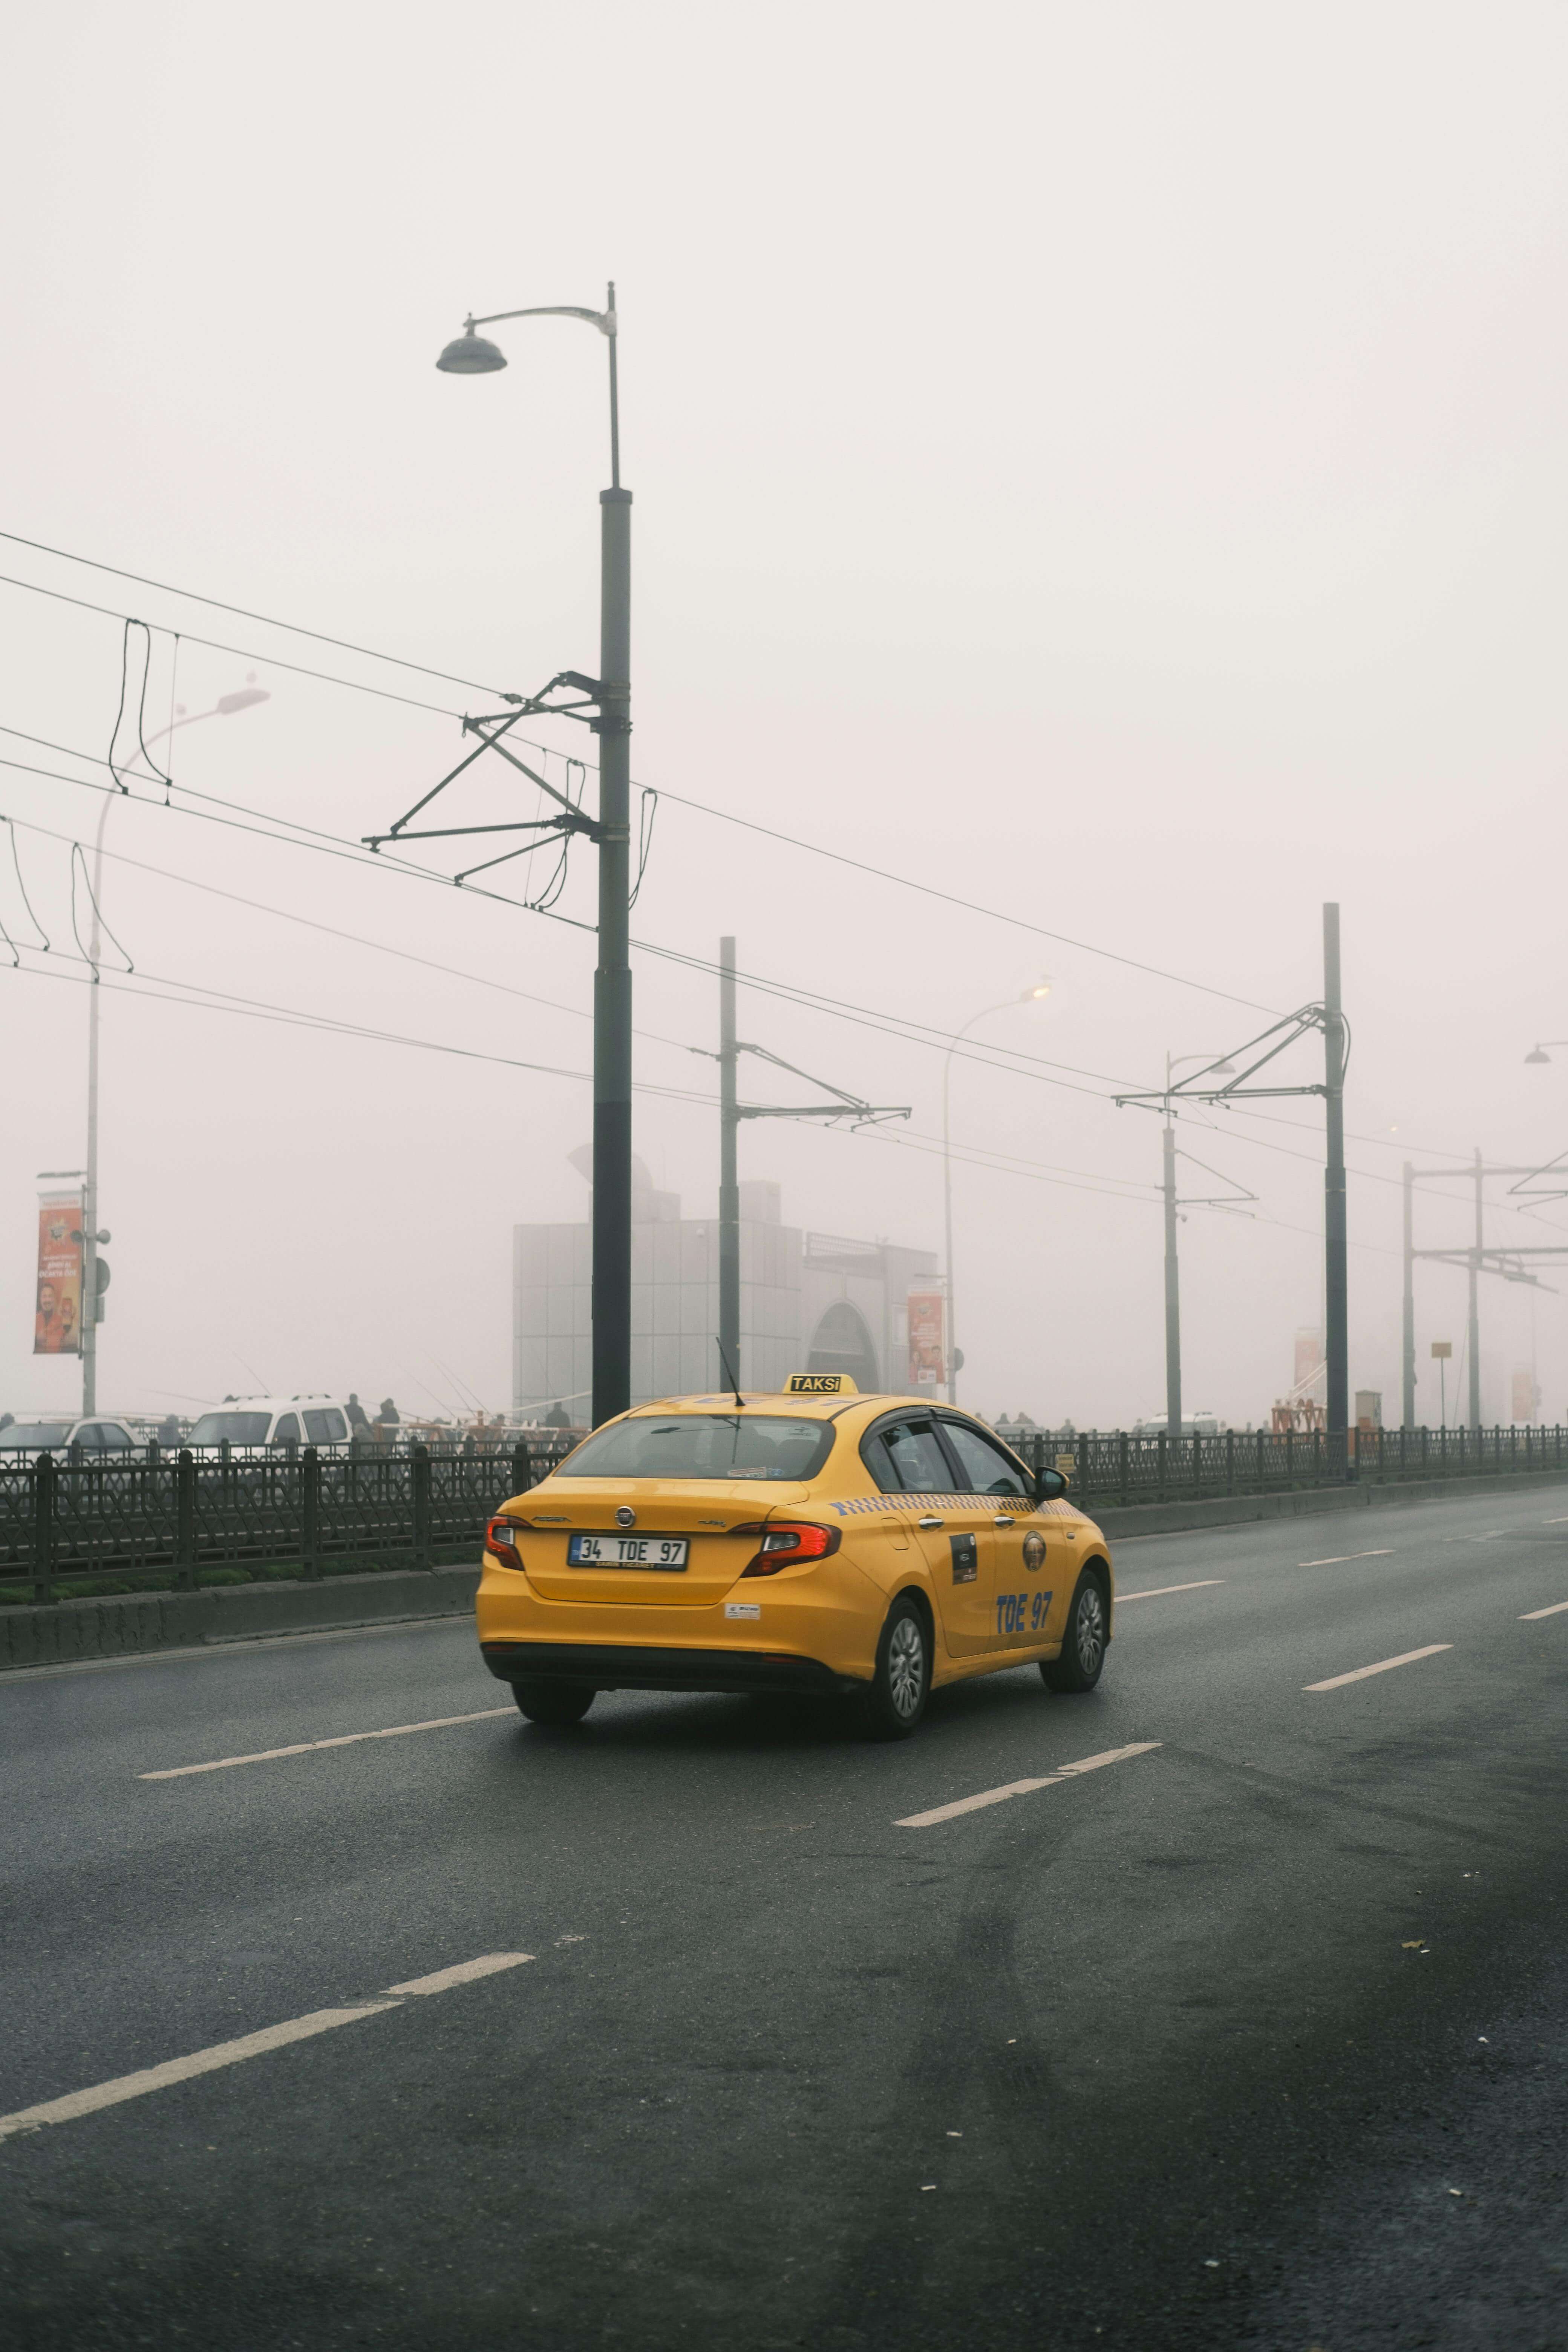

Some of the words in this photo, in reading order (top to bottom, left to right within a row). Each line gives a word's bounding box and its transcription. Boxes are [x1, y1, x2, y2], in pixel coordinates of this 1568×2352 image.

[582, 1539, 601, 1559] 34
[618, 1540, 648, 1561] TDE
[660, 1542, 682, 1562] 97
[996, 1594, 1028, 1634] TDE
[1031, 1591, 1053, 1630] 97
